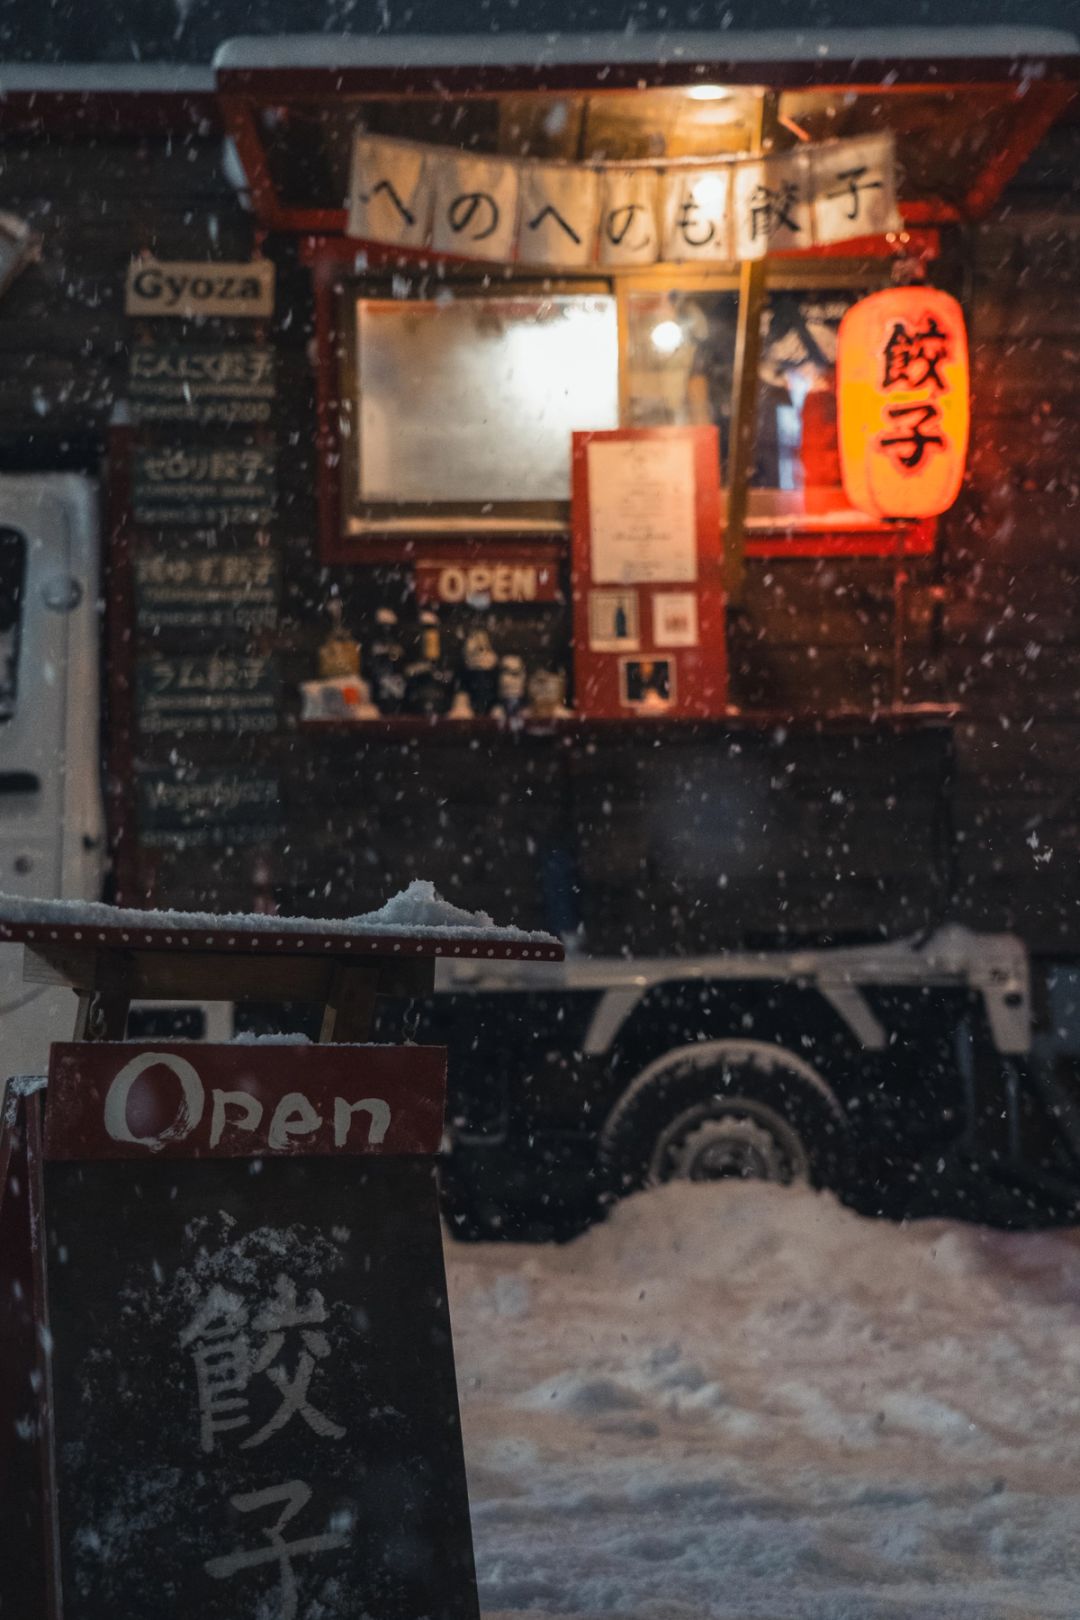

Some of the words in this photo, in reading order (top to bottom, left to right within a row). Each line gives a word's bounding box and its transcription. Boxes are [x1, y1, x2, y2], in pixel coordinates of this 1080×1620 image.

[361, 167, 883, 250] へのへのも餃子
[133, 270, 262, 305] Gyoza
[881, 317, 948, 468] 餃子
[439, 568, 537, 602] OPEN
[104, 1052, 391, 1152] Open
[180, 1274, 352, 1620] 餃子
